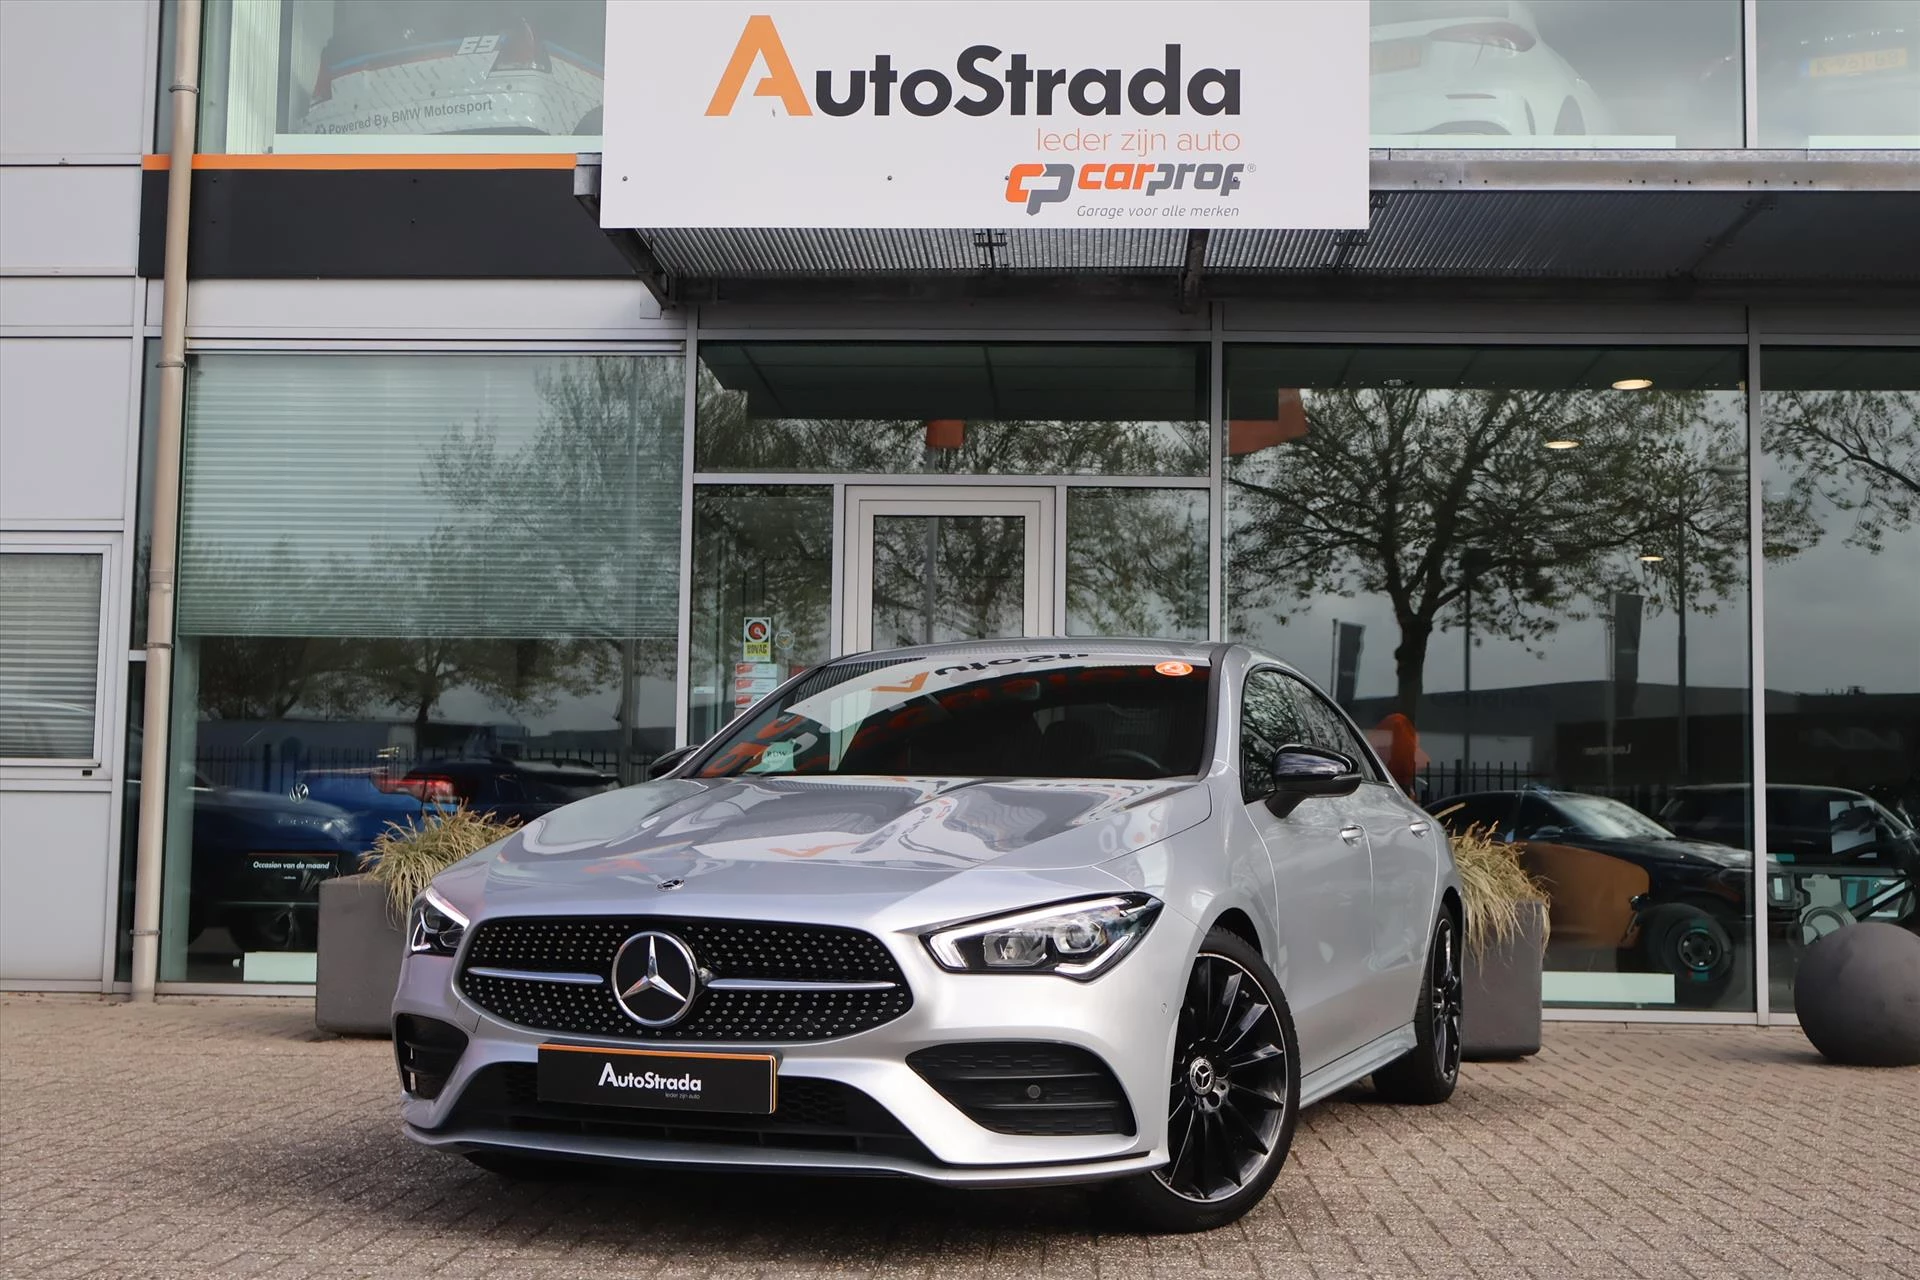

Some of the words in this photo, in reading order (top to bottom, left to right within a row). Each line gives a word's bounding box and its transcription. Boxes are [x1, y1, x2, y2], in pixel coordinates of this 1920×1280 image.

[456, 35, 500, 55] 69
[704, 15, 1241, 117] AutoStrada
[328, 115, 371, 135] Powered
[374, 114, 388, 127] By
[392, 107, 420, 122] BMW
[424, 99, 493, 117] Motorsport
[1121, 129, 1167, 157] zijn
[1177, 131, 1241, 151] auto
[1077, 206, 1124, 219] Garage
[1129, 208, 1158, 217] voor
[1162, 206, 1187, 217] alle
[1190, 207, 1240, 217] merken
[296, 861, 305, 869] de
[306, 861, 330, 869] maand
[598, 1062, 702, 1091] AutoStrada
